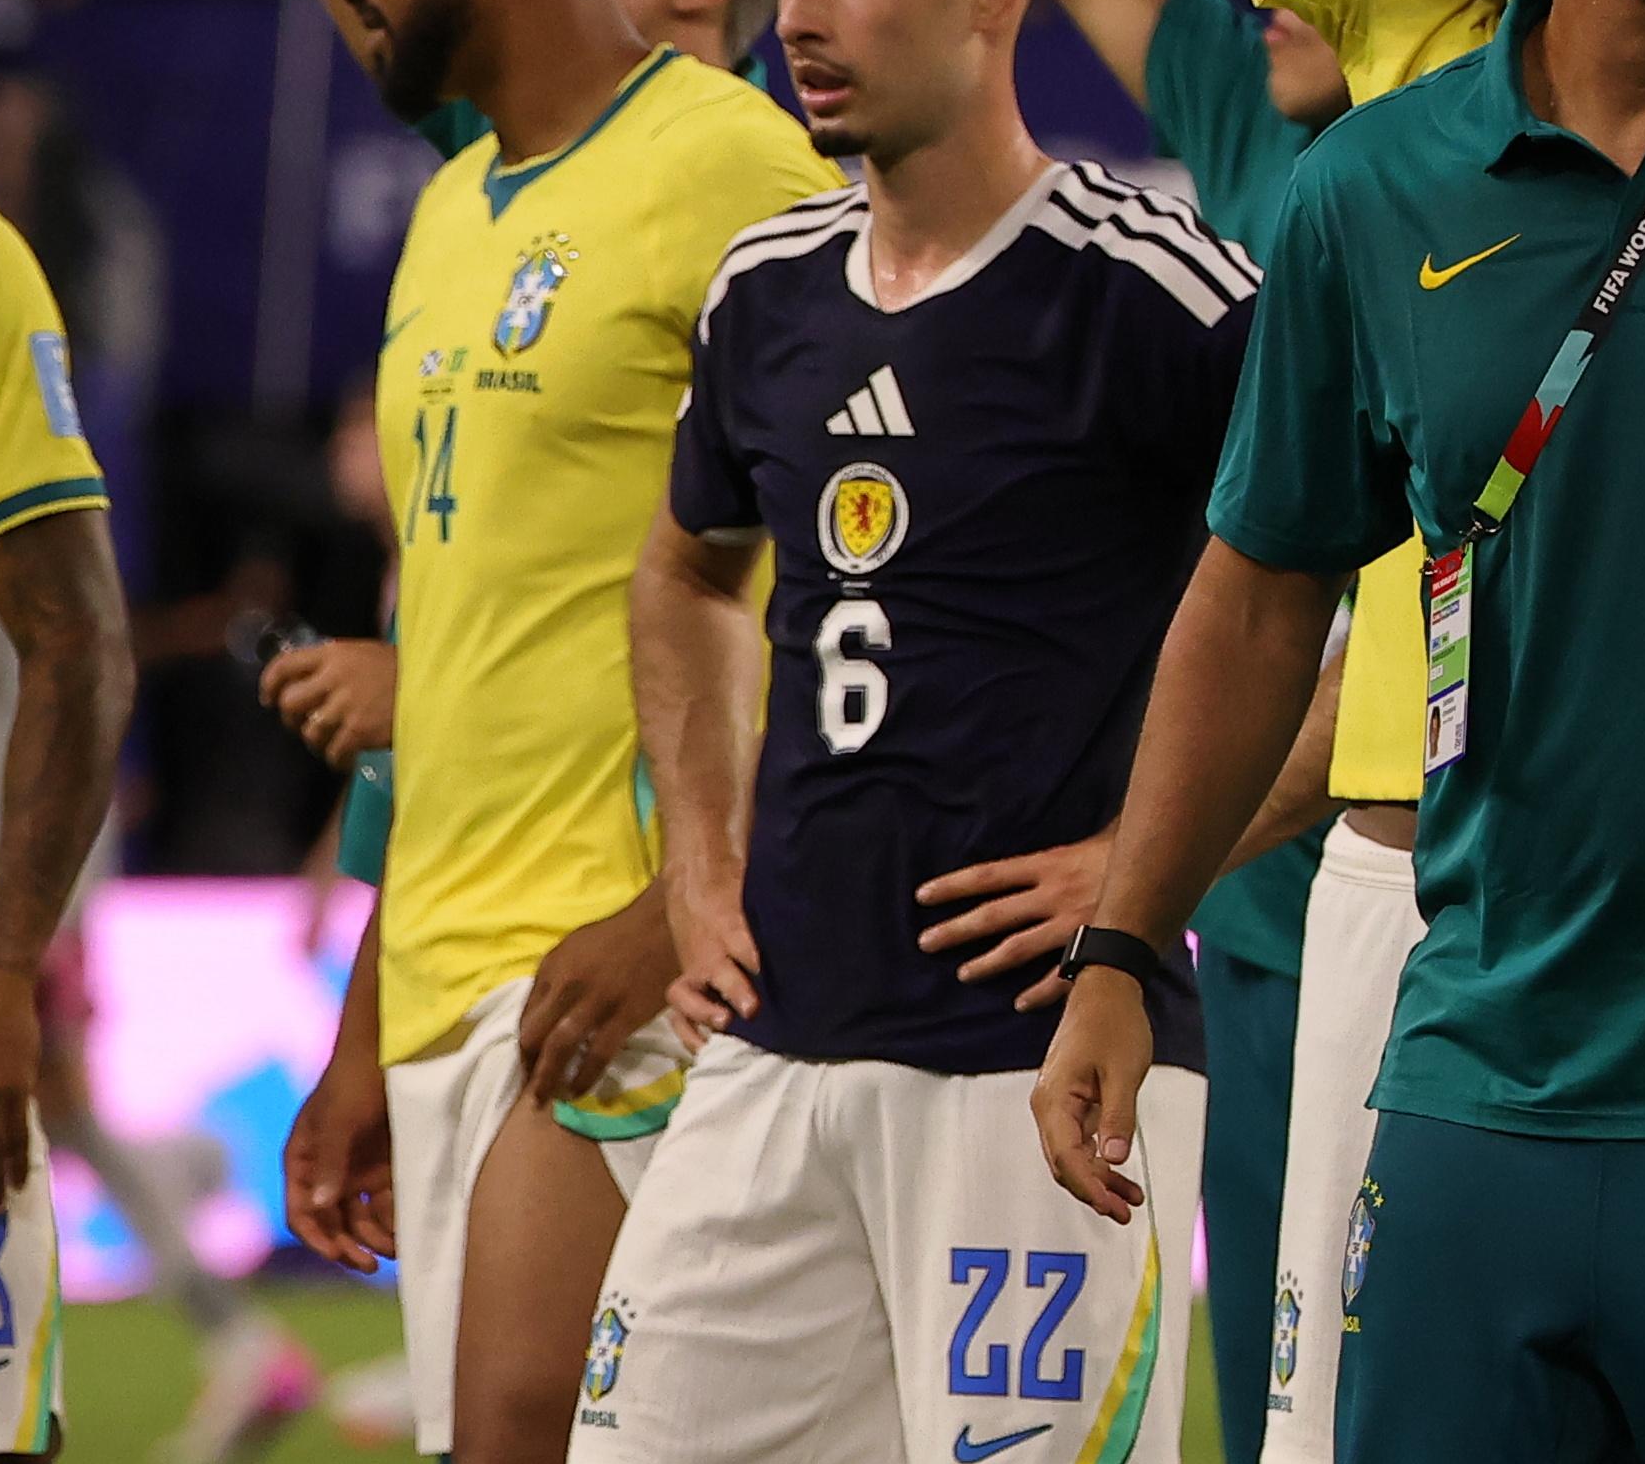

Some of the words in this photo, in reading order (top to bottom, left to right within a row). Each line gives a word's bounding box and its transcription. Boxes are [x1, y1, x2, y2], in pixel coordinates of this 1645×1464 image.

[1592, 269, 1631, 315] FIFA
[405, 405, 458, 543] 14
[814, 599, 893, 755] 6
[949, 1248, 1087, 1403] 22
